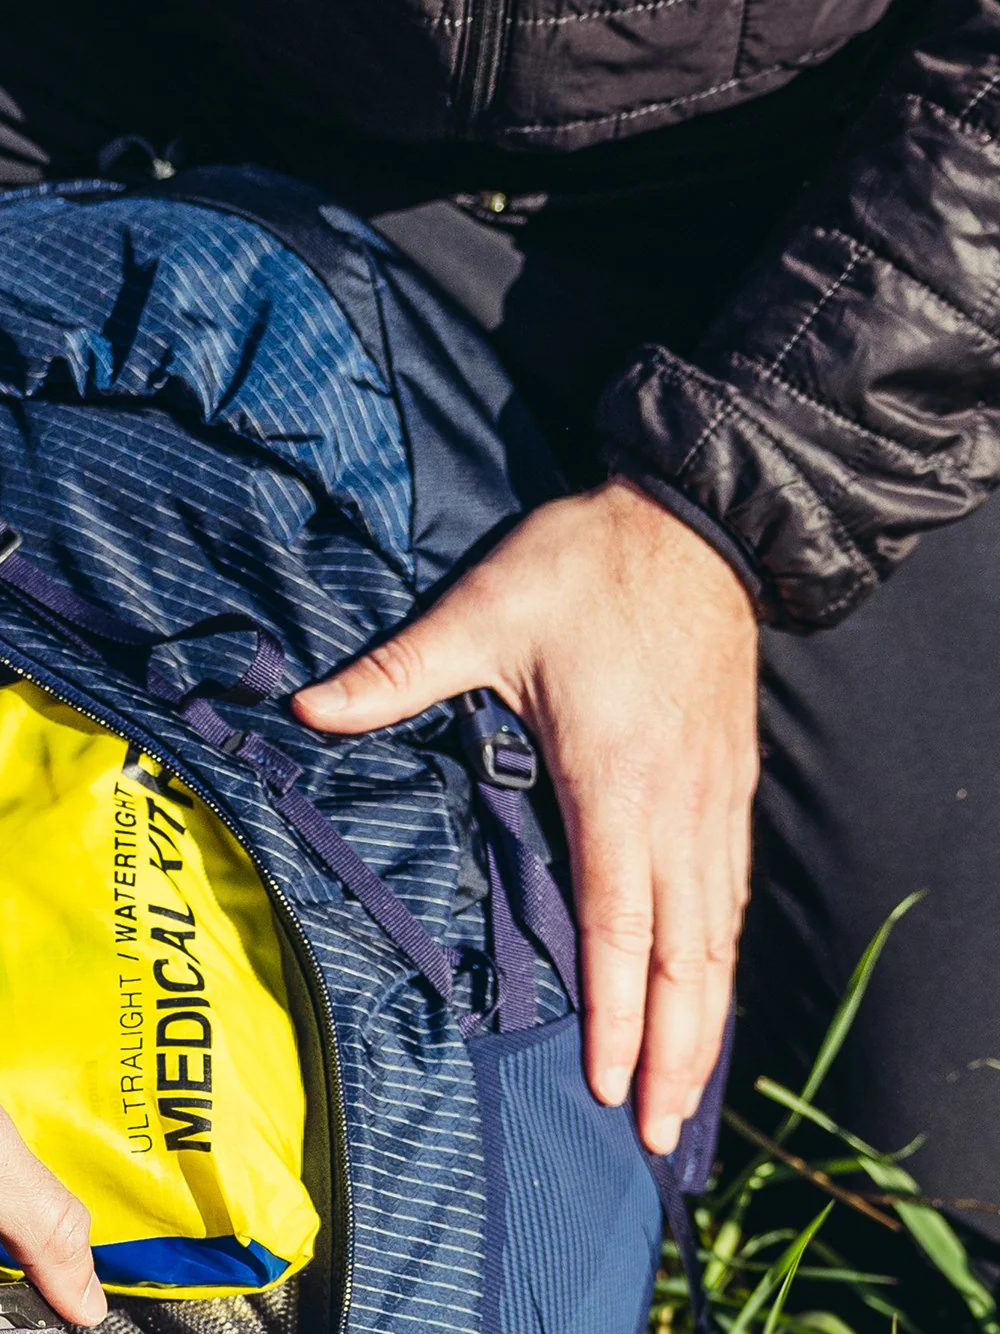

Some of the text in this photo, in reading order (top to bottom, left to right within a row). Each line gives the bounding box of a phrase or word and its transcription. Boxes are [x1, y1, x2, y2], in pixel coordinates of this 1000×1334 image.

[112, 781, 138, 943] WATERTIGHT
[145, 796, 187, 891] KIT
[119, 974, 153, 1154] ULTRALIGHT
[147, 902, 213, 1153] MEDICAL
